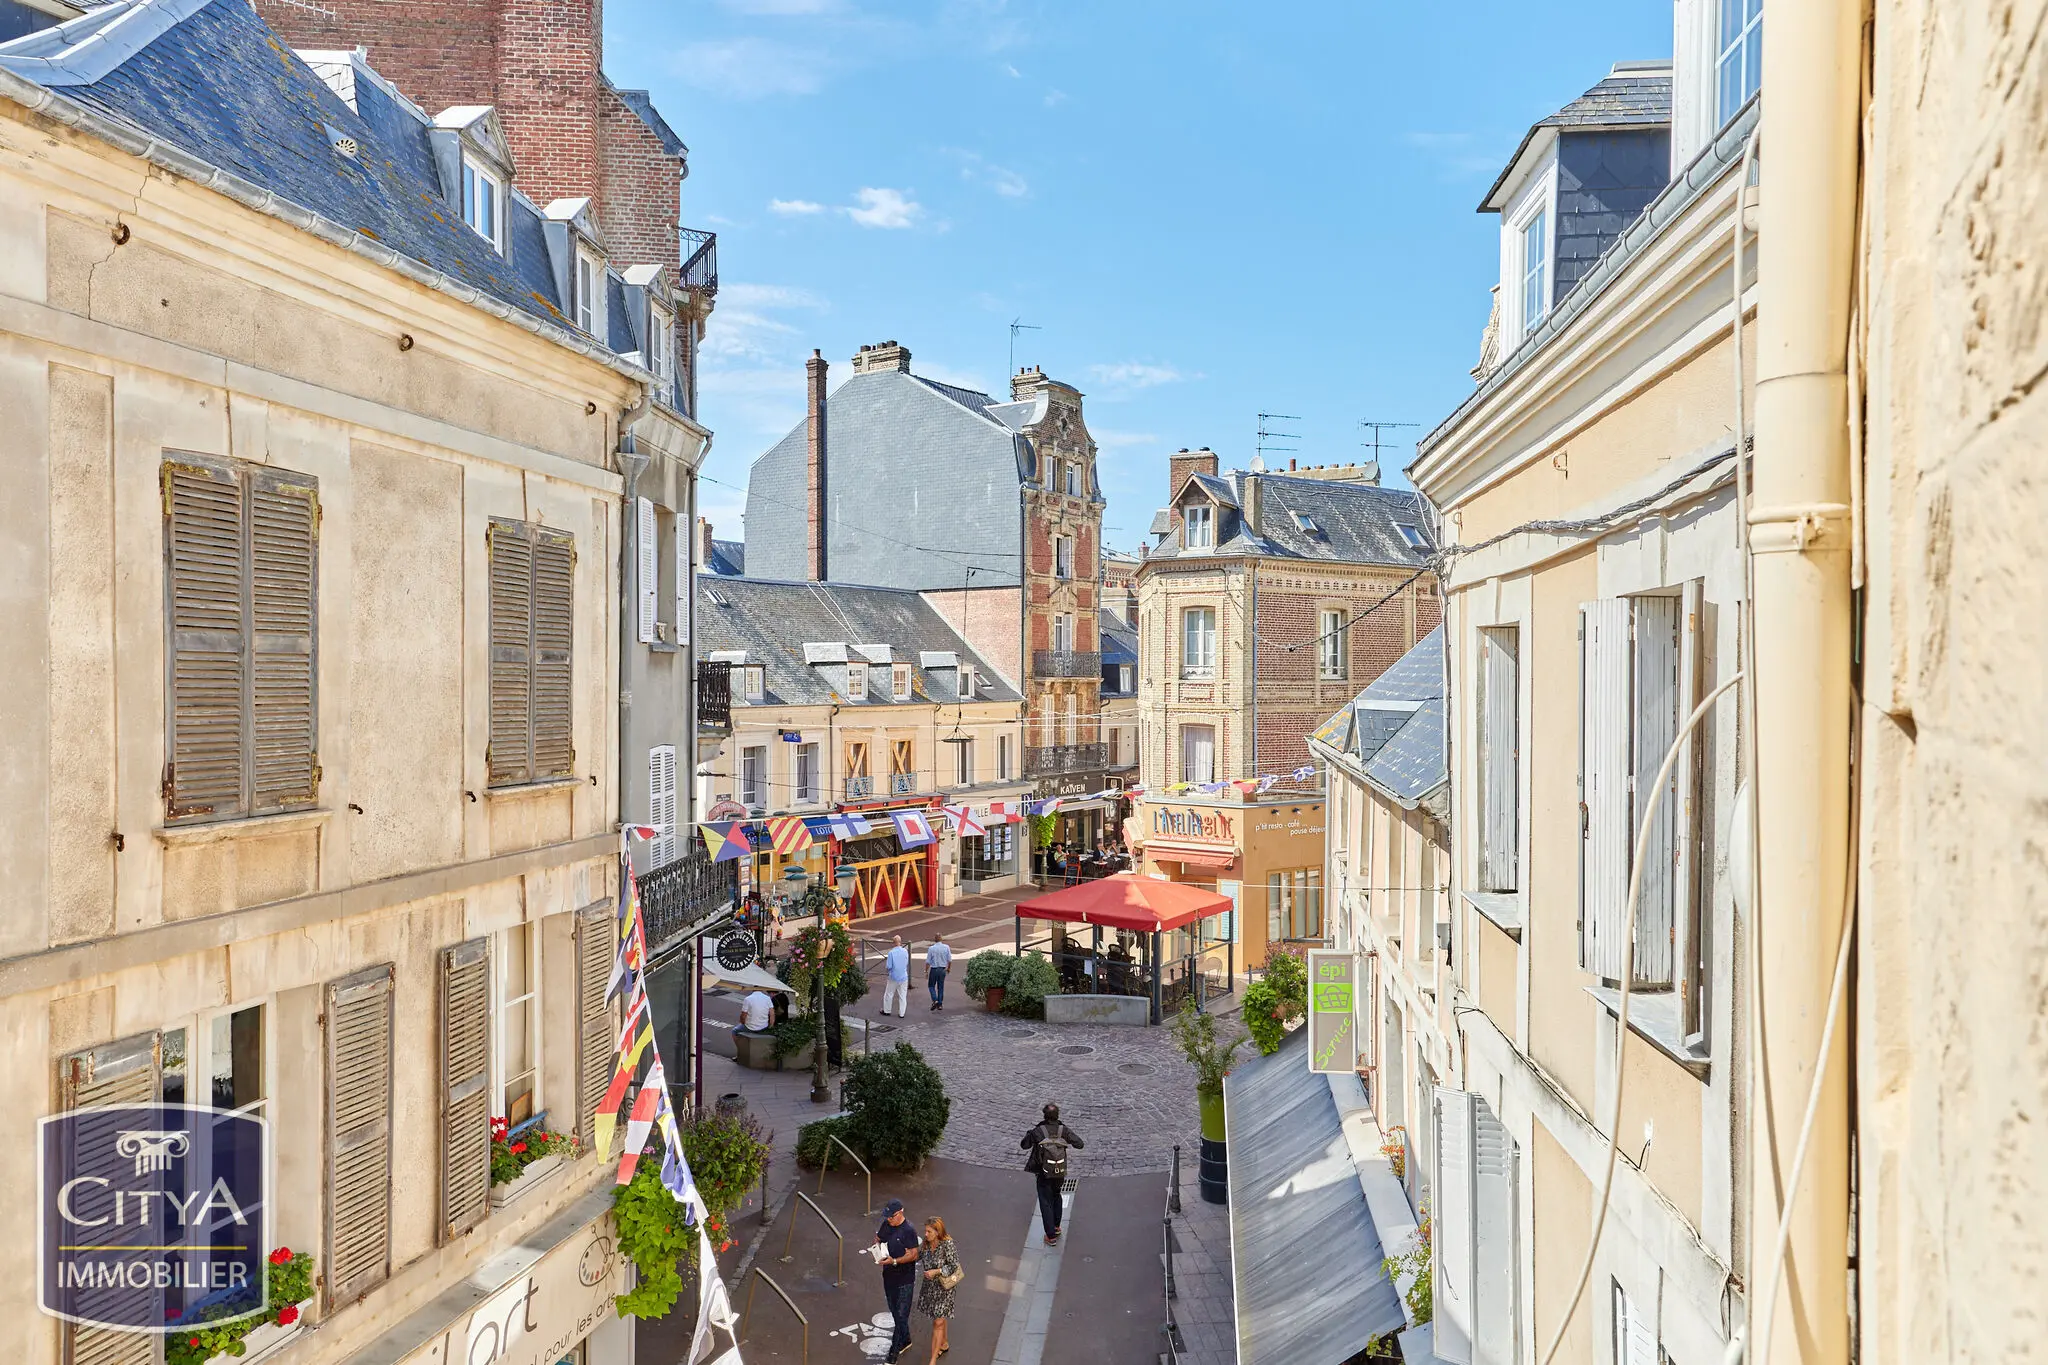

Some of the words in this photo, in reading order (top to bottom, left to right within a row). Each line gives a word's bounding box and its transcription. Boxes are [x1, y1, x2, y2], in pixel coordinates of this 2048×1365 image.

[720, 934, 753, 948] BOULANGERIE
[719, 953, 754, 969] ARTISANALE
[1319, 962, 1346, 981] épi
[1314, 1016, 1352, 1070] Service
[543, 1330, 572, 1365] pour
[576, 1313, 592, 1336] les
[595, 1292, 616, 1318] arts
